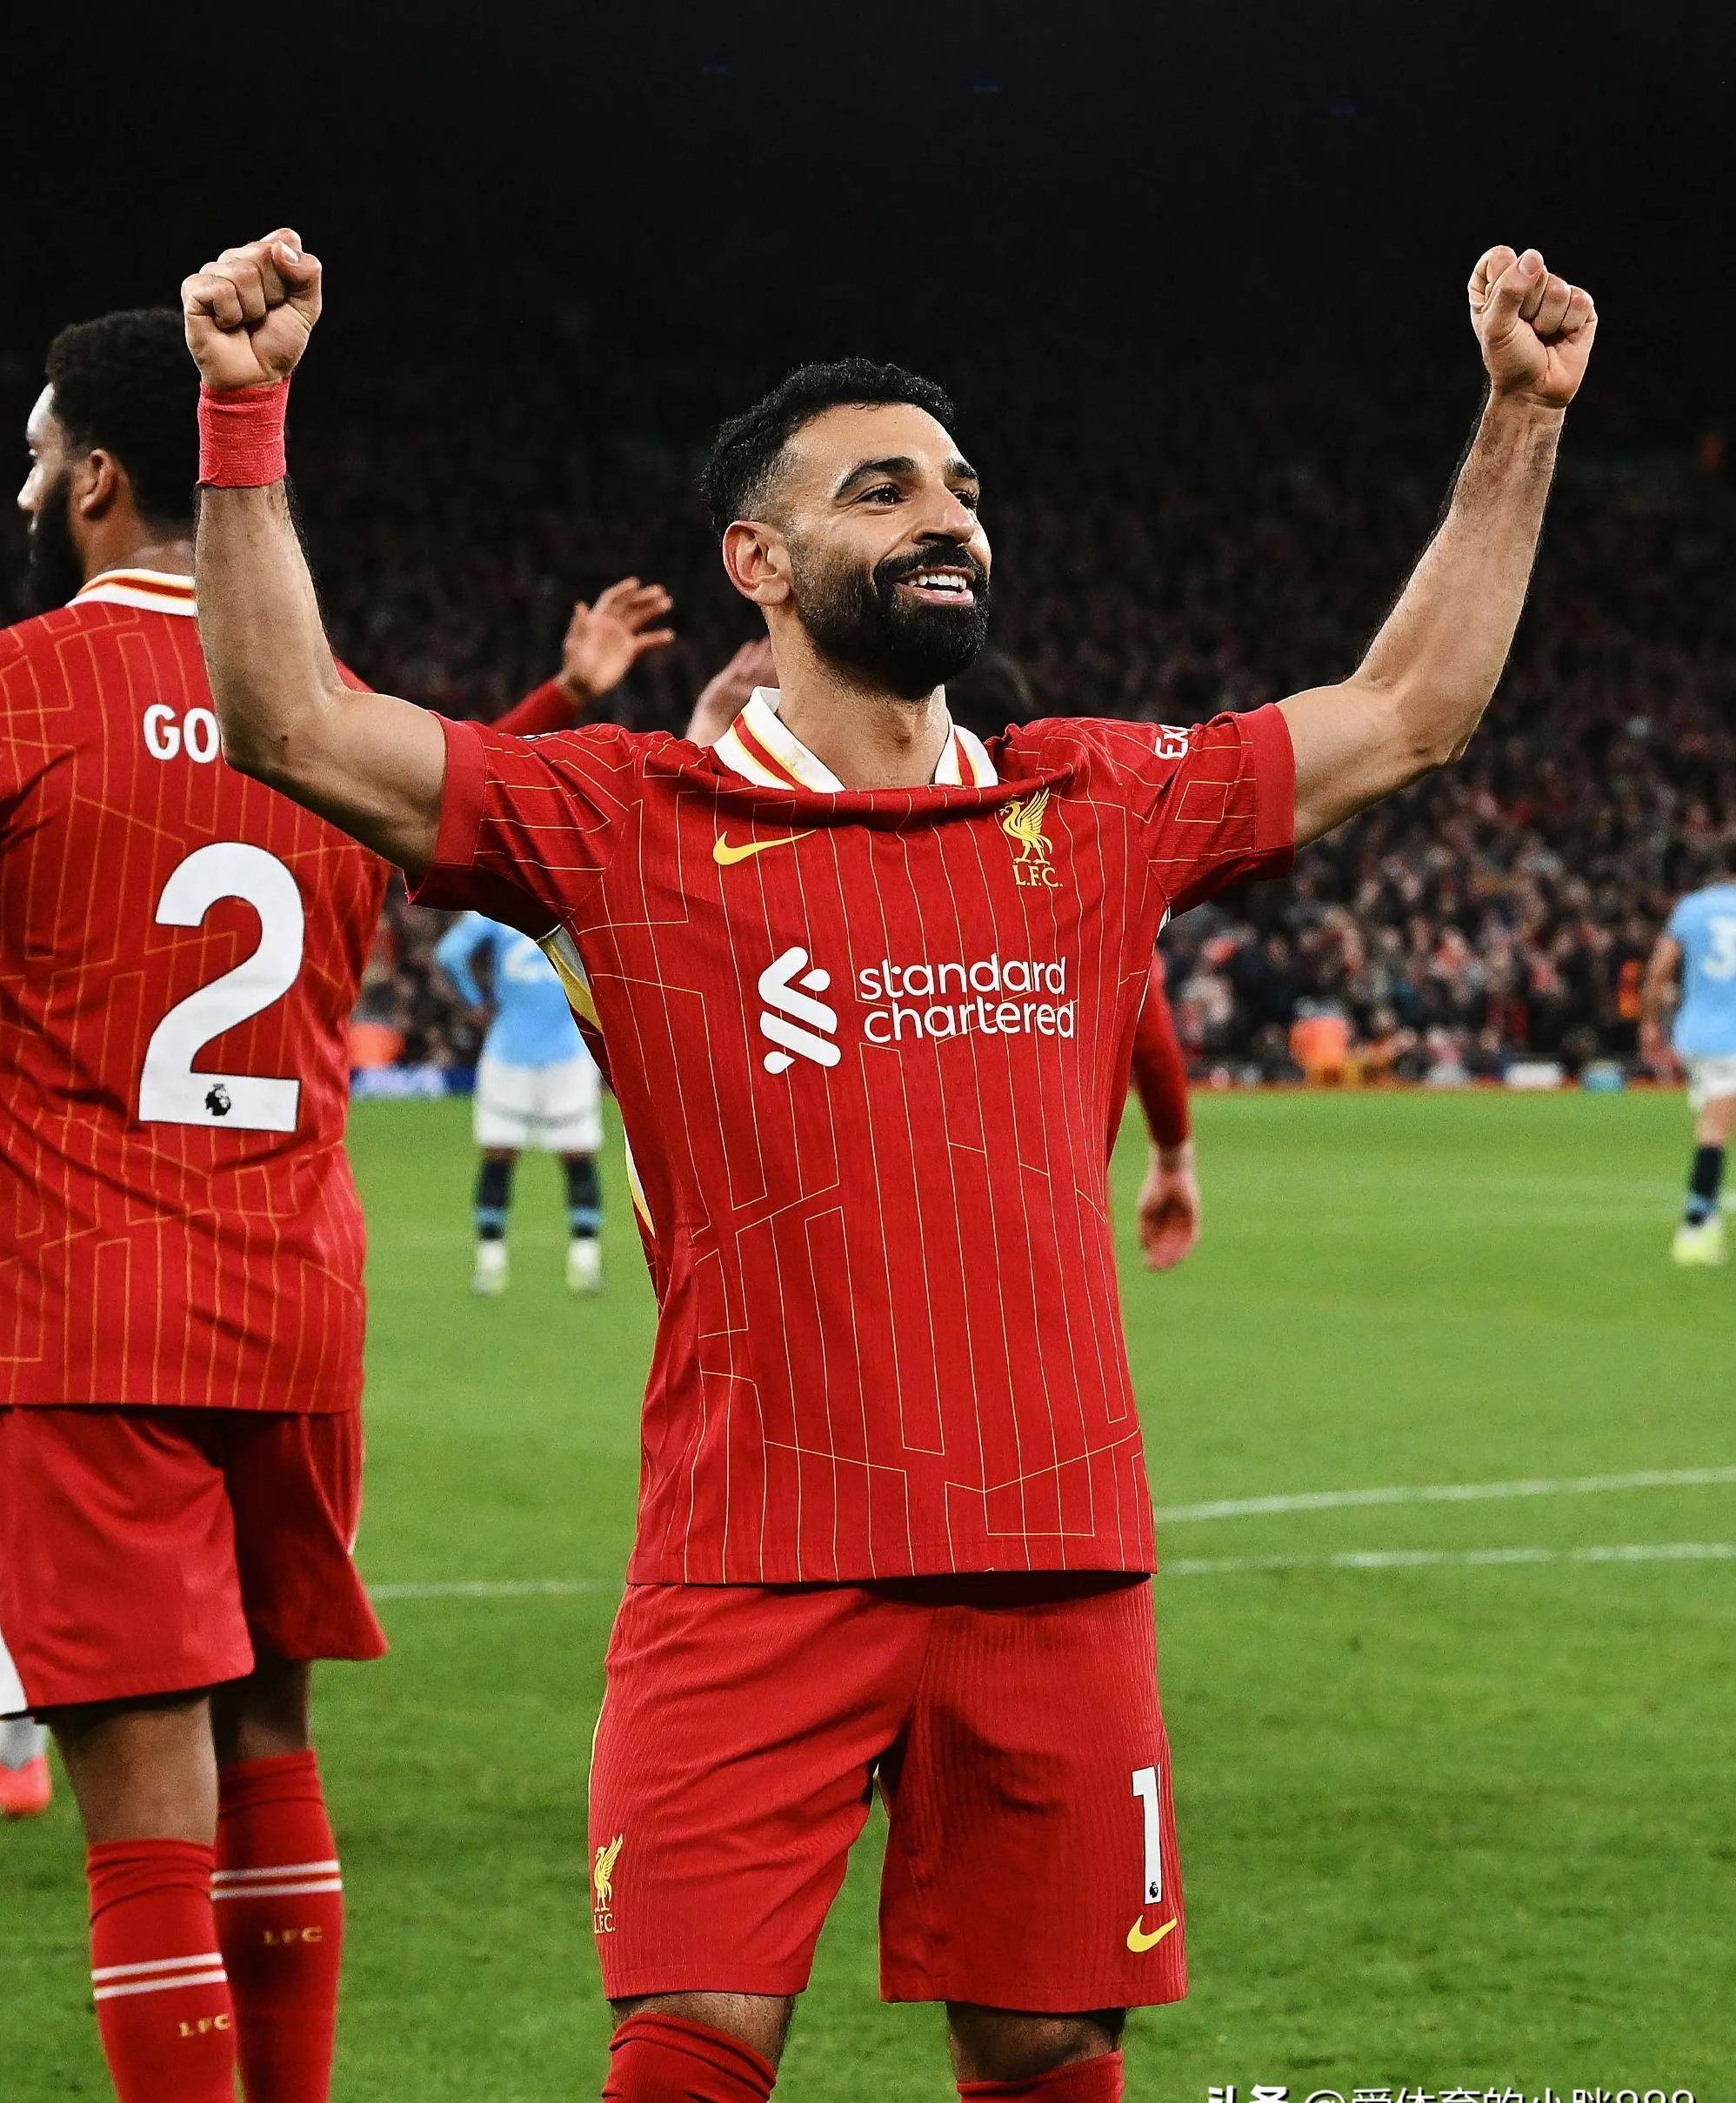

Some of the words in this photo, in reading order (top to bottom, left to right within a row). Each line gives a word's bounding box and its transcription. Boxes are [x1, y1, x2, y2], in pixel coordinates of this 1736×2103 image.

[144, 704, 220, 764] GO
[138, 841, 305, 1132] 2
[859, 953, 1066, 1000] standard
[863, 999, 1074, 1044] chartered
[1132, 1762, 1162, 1905] 1
